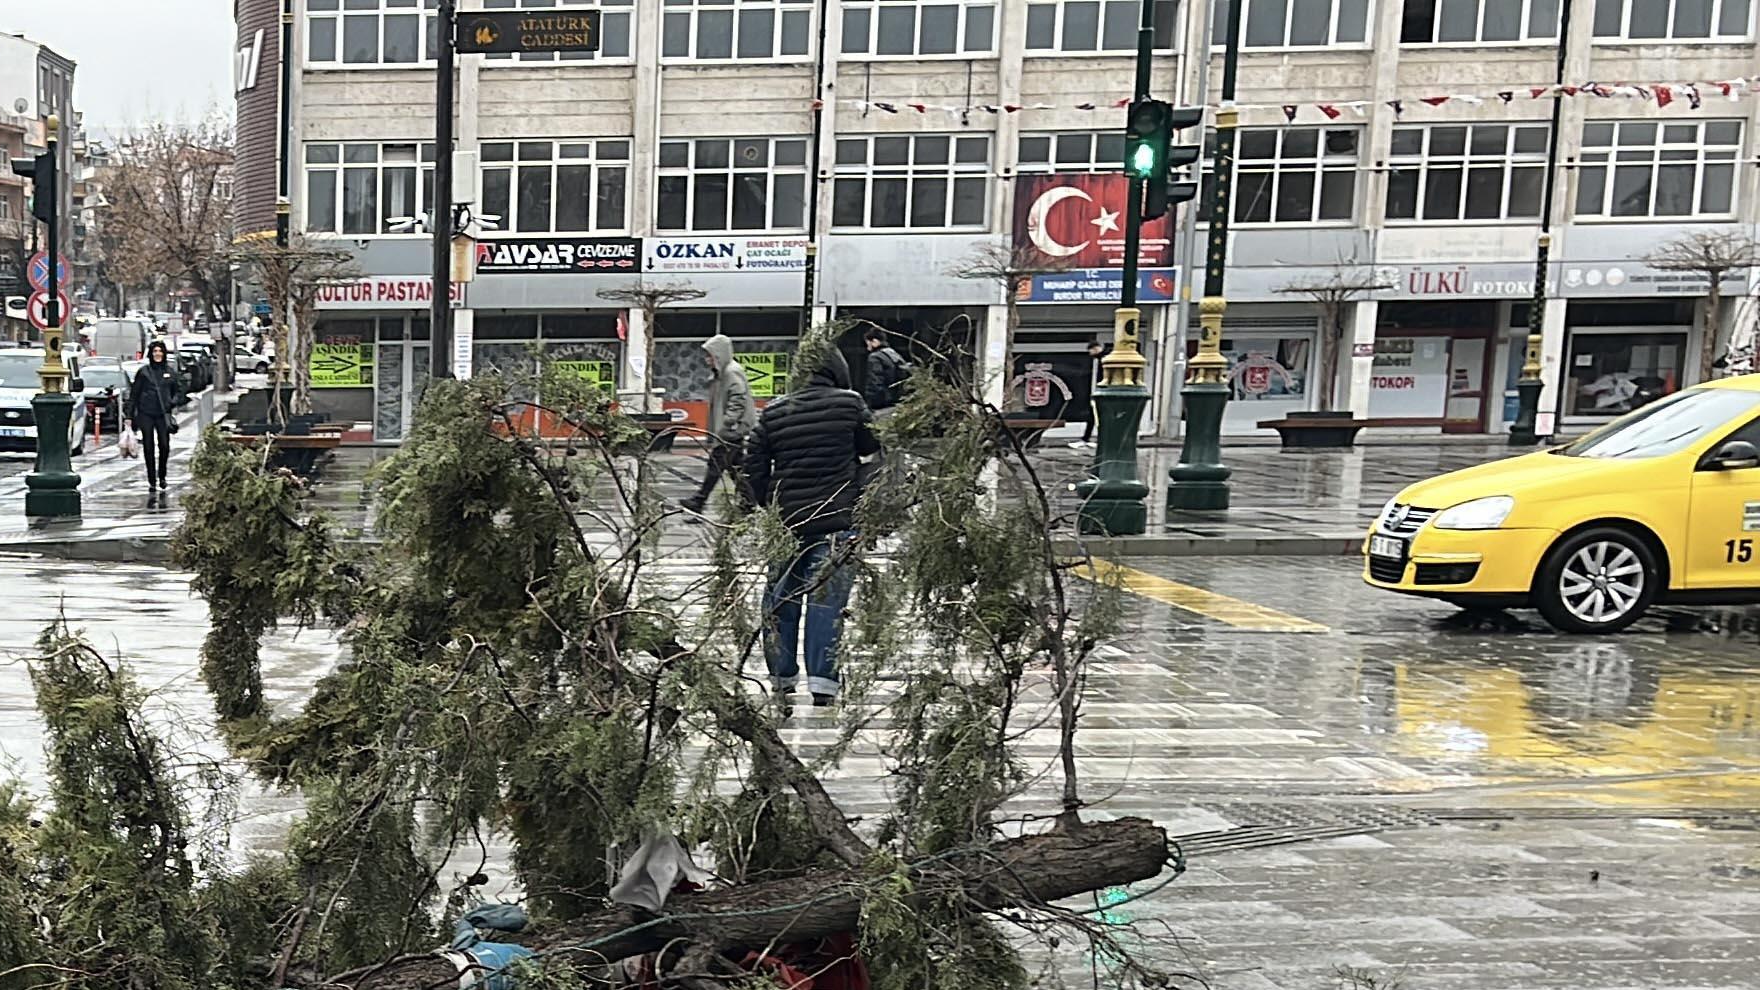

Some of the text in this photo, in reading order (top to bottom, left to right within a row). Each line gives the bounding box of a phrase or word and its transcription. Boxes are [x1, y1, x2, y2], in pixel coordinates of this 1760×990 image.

[518, 16, 592, 31] ATATÜRK
[656, 240, 735, 259] ÖZKAN
[746, 241, 779, 249] EMANET
[1408, 266, 1469, 295] ÜLKÜ
[1725, 538, 1754, 563] 15
